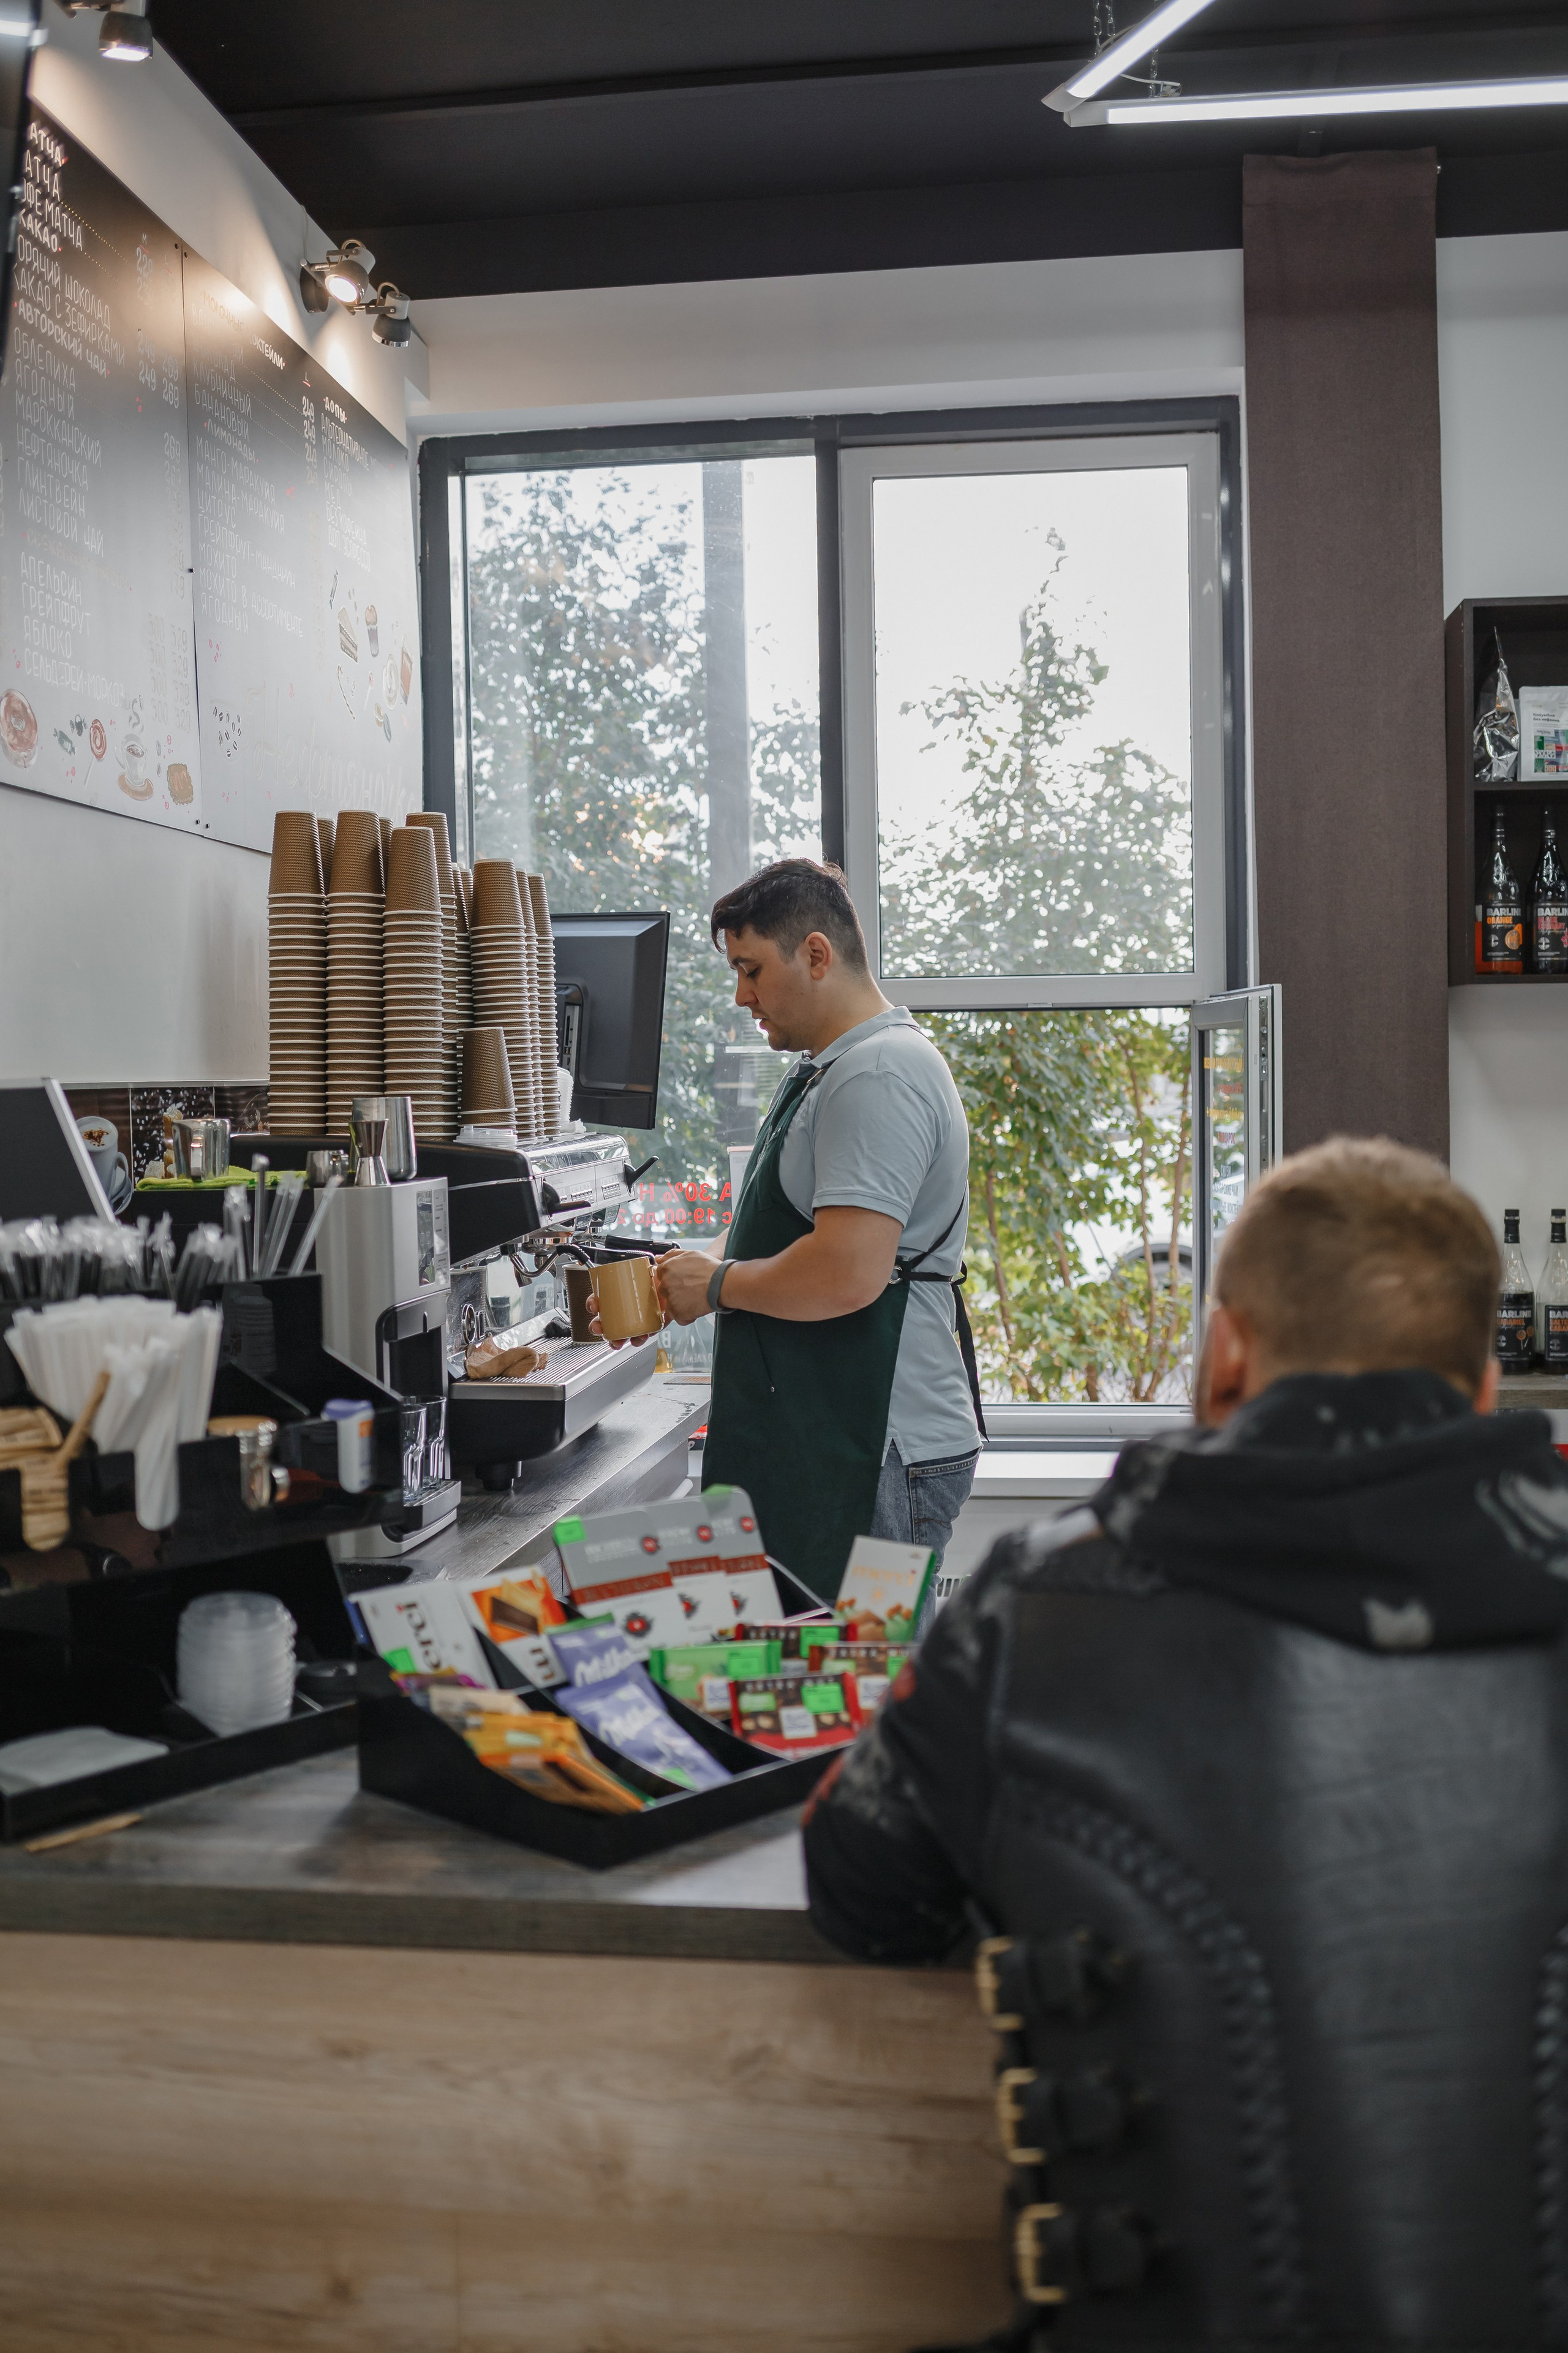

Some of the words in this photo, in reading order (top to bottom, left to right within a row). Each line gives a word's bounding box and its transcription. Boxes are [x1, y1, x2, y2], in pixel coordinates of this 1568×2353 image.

[25, 149, 60, 202] АТЧА
[31, 123, 62, 167] АТЧА
[46, 198, 83, 251] МАТЧА
[18, 235, 61, 292] ОРЯЧИЙ
[65, 273, 111, 333] ШОКОЛАД
[14, 327, 76, 393] ОБЛЕПИХА
[18, 298, 83, 360] АВТОРСКИЙ
[86, 349, 107, 379] ЧАЙ
[55, 293, 61, 319] С
[65, 302, 125, 368] ЗЕФИРКАМИ
[15, 358, 74, 421] ЯГОДНЫЙ
[139, 360, 156, 391] 249
[162, 377, 179, 409] 269
[194, 355, 252, 418] КЛУБНИЧНЫЙ
[195, 383, 249, 441] БАНАНОВЫЙ
[15, 389, 101, 468] МАРОККАНСКИЙ
[17, 423, 88, 491] НЕФТЯНОЧКА
[208, 418, 255, 464] ЛИМОНАДЫ
[322, 435, 349, 472] МОЛОКО
[18, 456, 85, 519] ГЛИНТВЕЙН
[197, 435, 275, 505] МАНГО-МАРАКУЙЯ
[197, 463, 284, 536] МАЛИНА-МАРАКУЙЯ
[19, 488, 77, 543] ЛИСТОВОЙ
[84, 523, 104, 557] ЧАЙ
[198, 488, 236, 528] ЦИТРУС
[21, 551, 82, 605] АПЕЛЬСИН
[198, 514, 295, 590] ГРЕЙПФРУТ-МАНДАРИН
[199, 542, 236, 578] МОХИТО
[22, 582, 91, 636] ГРЕЙПФРУТ
[200, 567, 236, 603] МОХИТО
[242, 586, 247, 608] В
[252, 592, 303, 637] АССОРТИМЕНТЕ
[202, 592, 248, 634] ЯГОДНЫЙ
[24, 615, 72, 659] ЯБЛОКО
